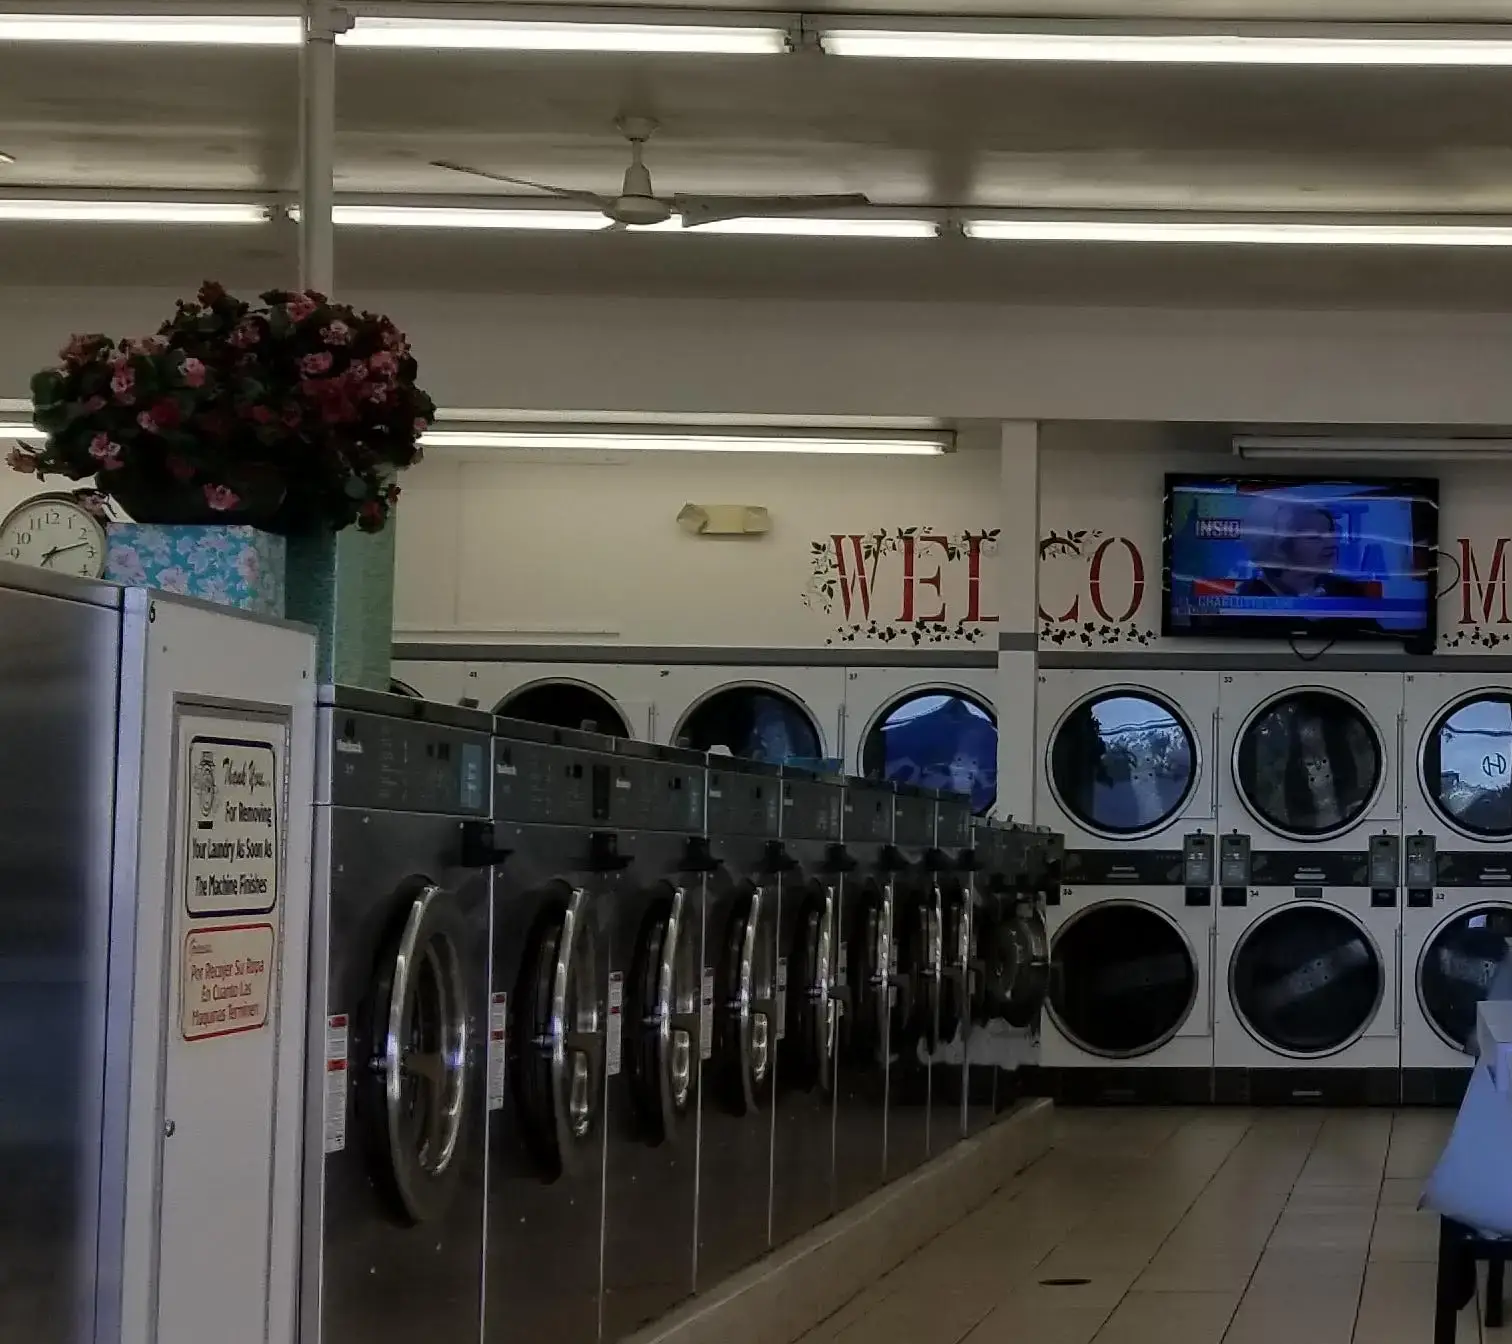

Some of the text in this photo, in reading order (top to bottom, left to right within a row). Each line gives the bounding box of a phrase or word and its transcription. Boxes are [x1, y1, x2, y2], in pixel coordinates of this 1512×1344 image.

[45, 512, 60, 525] 12
[16, 532, 31, 545] 10
[222, 757, 247, 786] Thank
[225, 801, 272, 827] For Removing
[192, 837, 207, 859] Your
[207, 838, 235, 863] Laundry
[246, 838, 263, 859] Soon
[264, 838, 273, 858] As
[195, 874, 268, 896] The Machine Finishes
